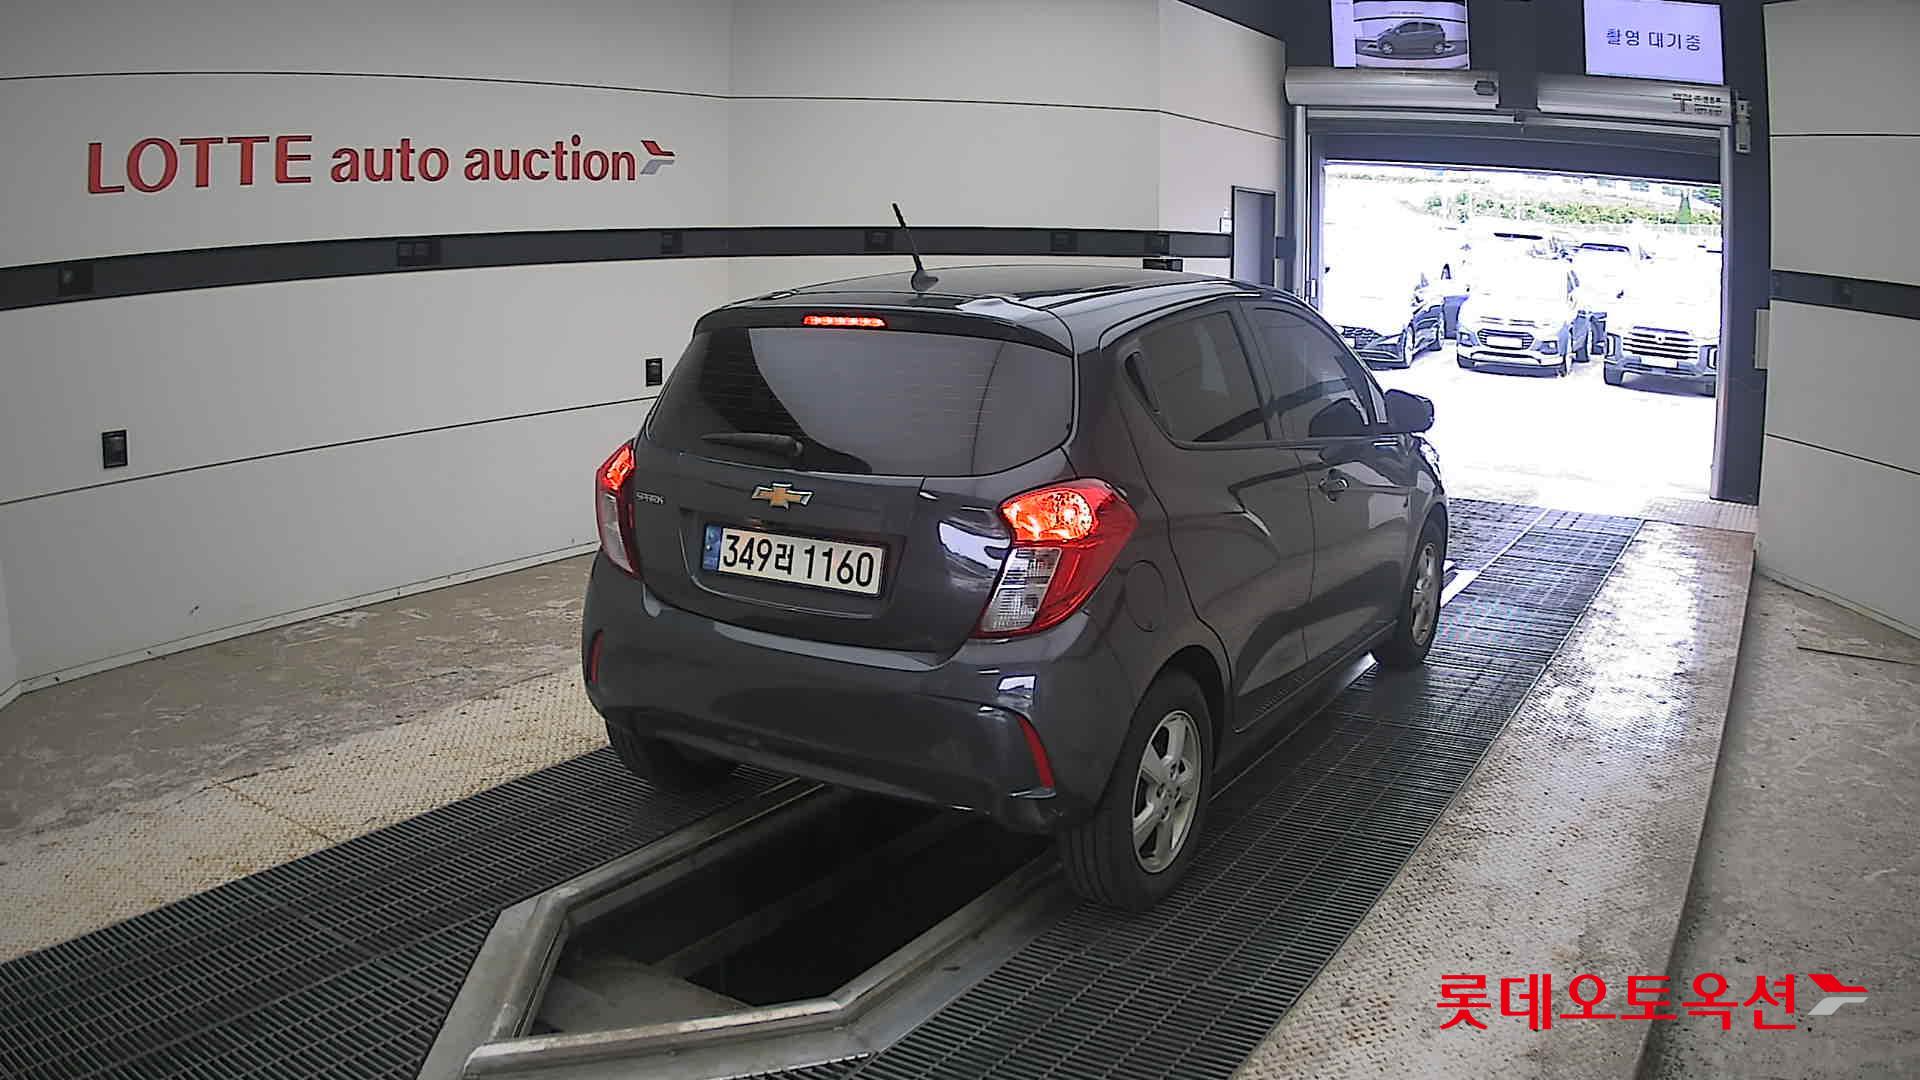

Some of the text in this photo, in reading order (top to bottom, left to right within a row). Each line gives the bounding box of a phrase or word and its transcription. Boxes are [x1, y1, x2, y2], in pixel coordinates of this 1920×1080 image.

[1647, 31, 1701, 51] 대기중
[88, 134, 636, 194] LOTTE auto auction
[636, 491, 664, 504] SPARK
[722, 534, 875, 588] 349러 1160
